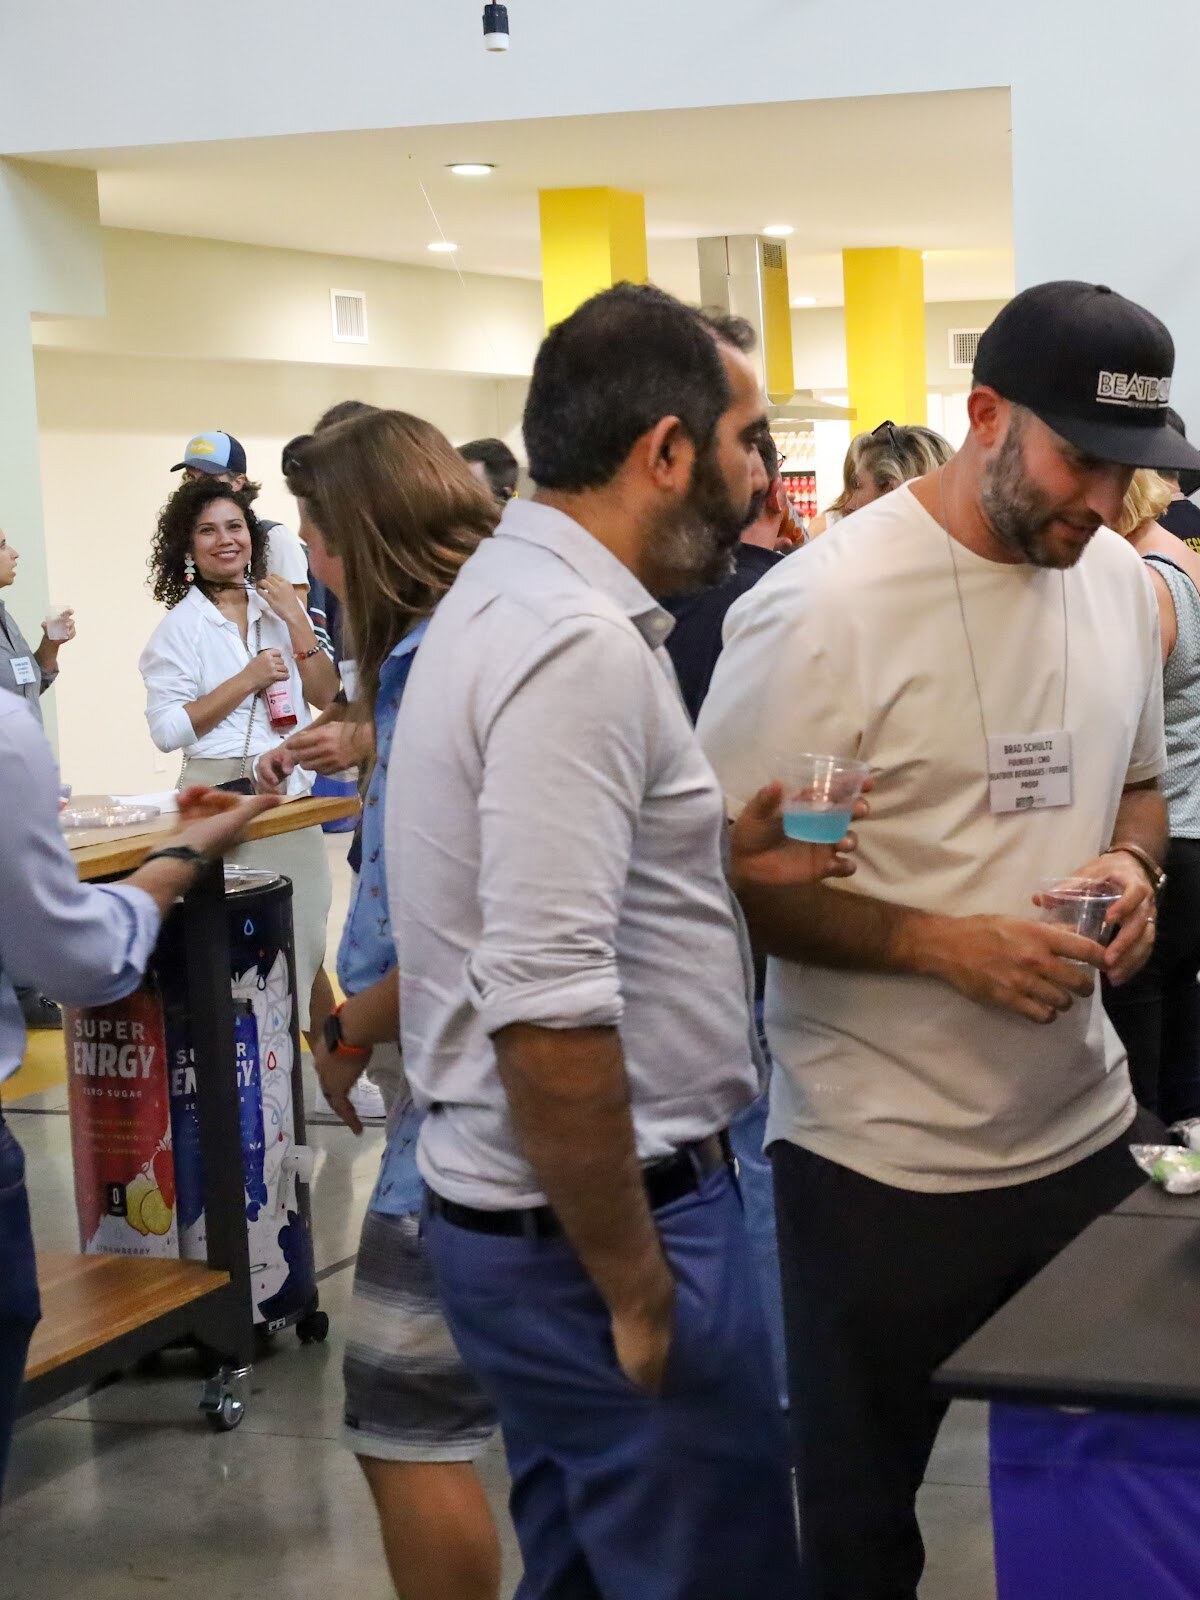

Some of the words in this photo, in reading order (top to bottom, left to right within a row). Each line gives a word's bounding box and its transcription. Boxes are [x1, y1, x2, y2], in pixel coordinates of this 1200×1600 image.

[1003, 743, 1023, 755] BRAD
[1023, 740, 1053, 753] SCHULTZ
[1007, 757, 1034, 767] FOUNDER
[75, 1019, 145, 1040] SUPER
[73, 1041, 156, 1078] ENRGY
[83, 1087, 103, 1097] ZERO
[107, 1089, 142, 1098] SUGAR
